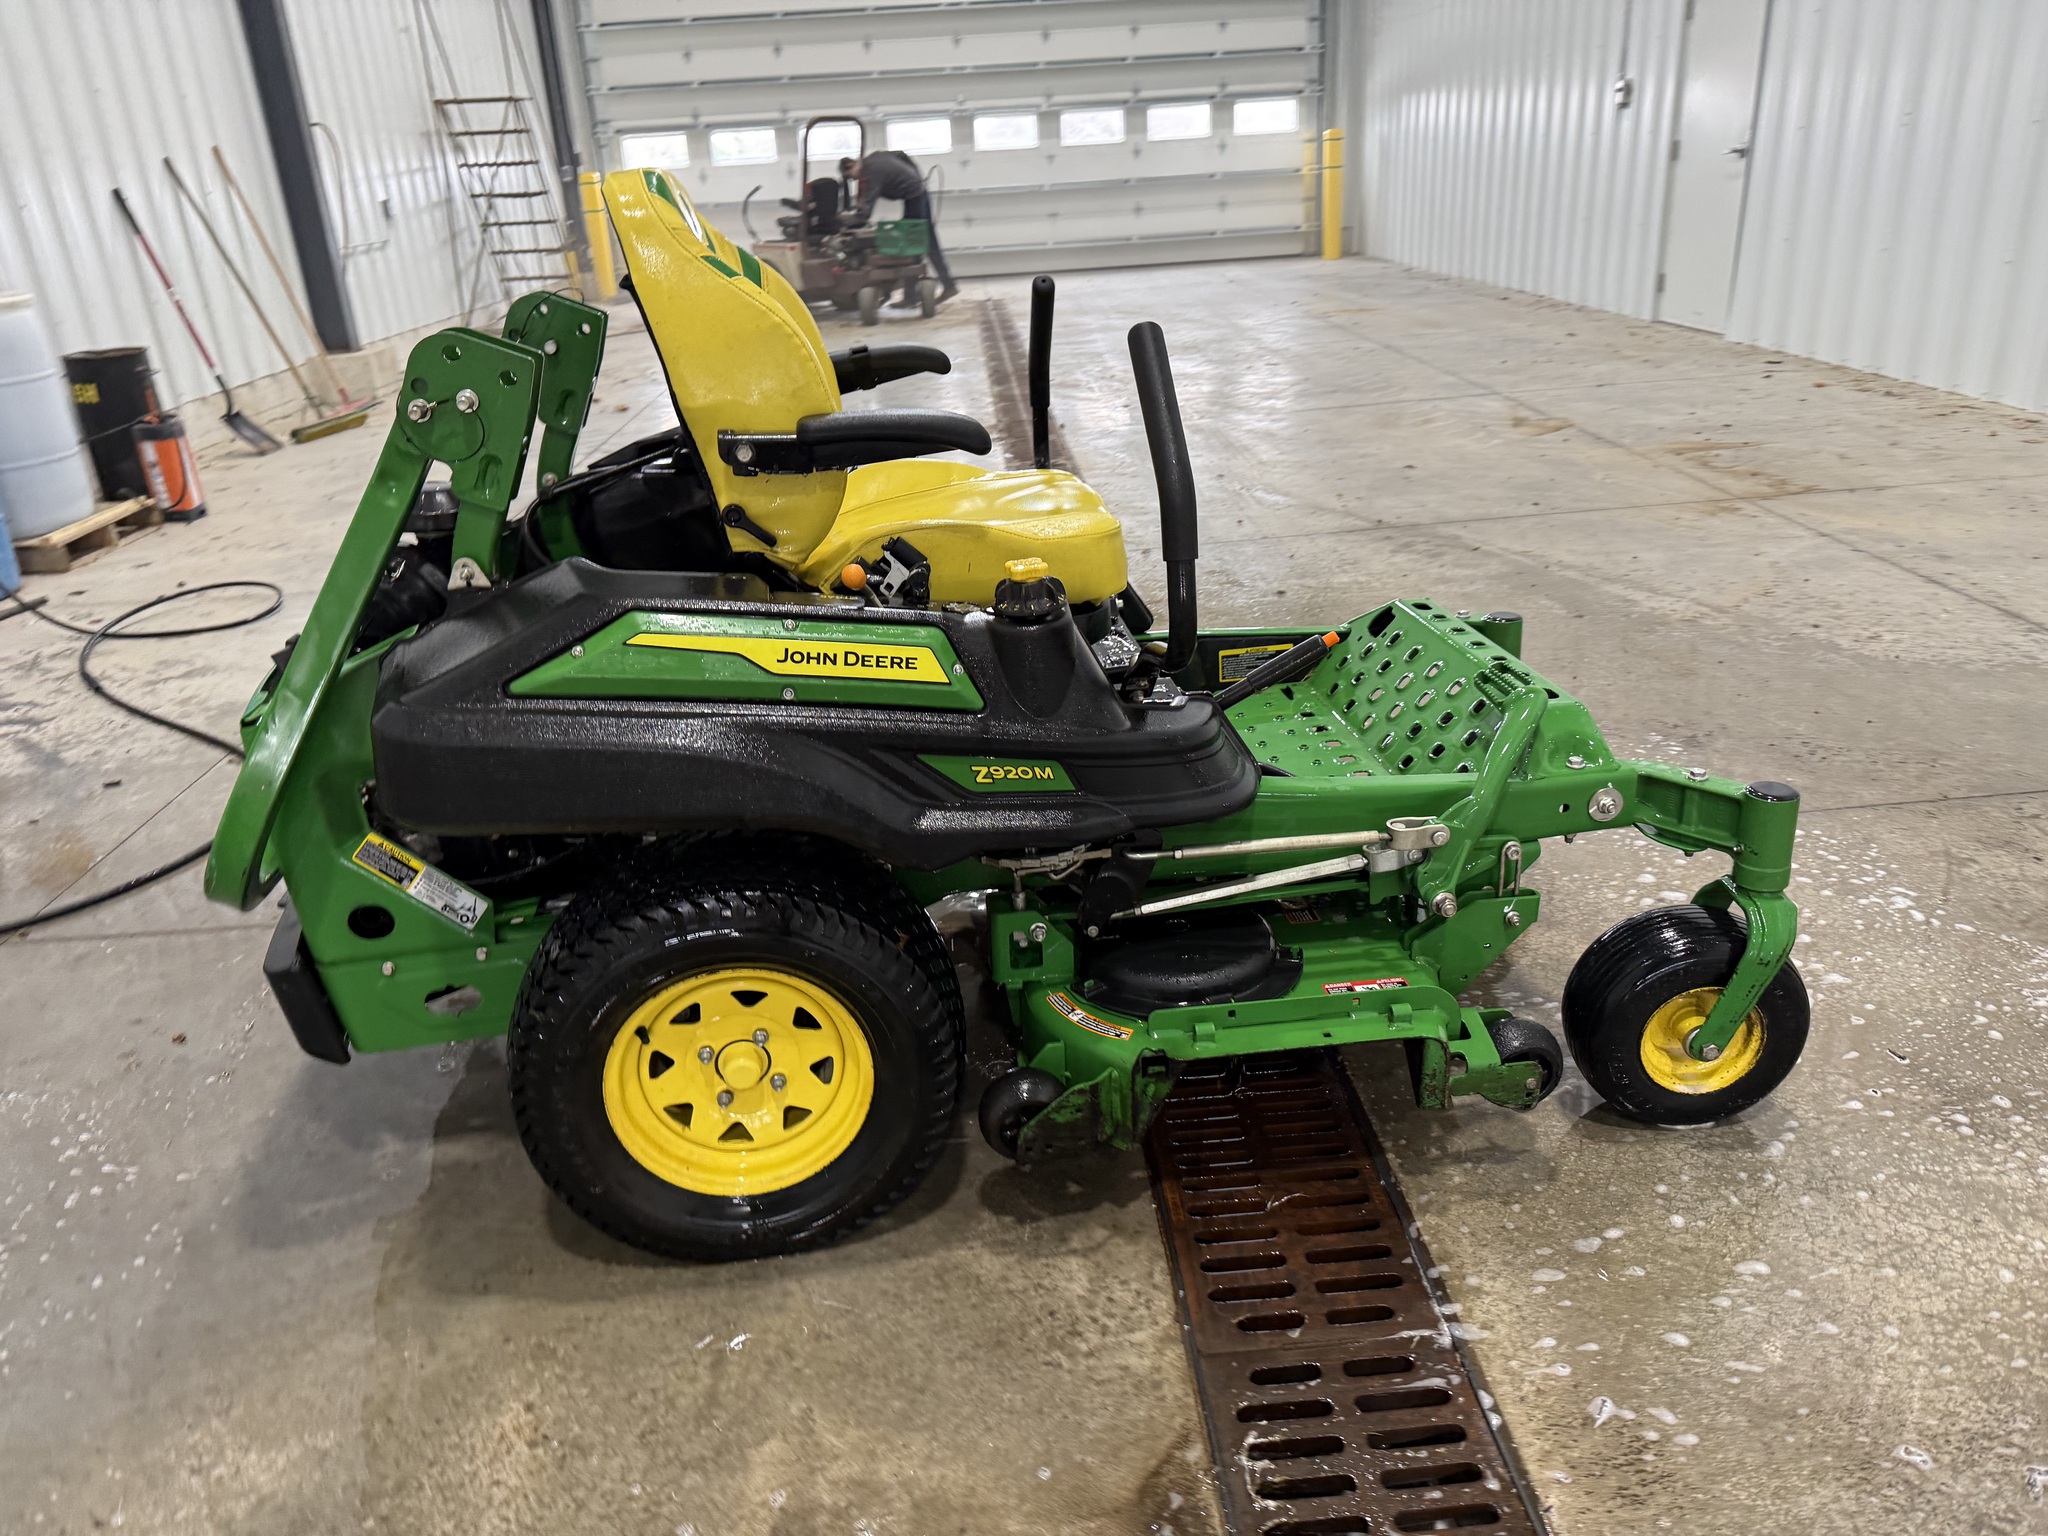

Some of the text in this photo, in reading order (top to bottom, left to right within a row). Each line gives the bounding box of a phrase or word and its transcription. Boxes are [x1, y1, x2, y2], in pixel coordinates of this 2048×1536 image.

[776, 647, 918, 670] JOHN DEERE
[970, 765, 1055, 784] Z920M
[383, 843, 413, 865] CAUTION
